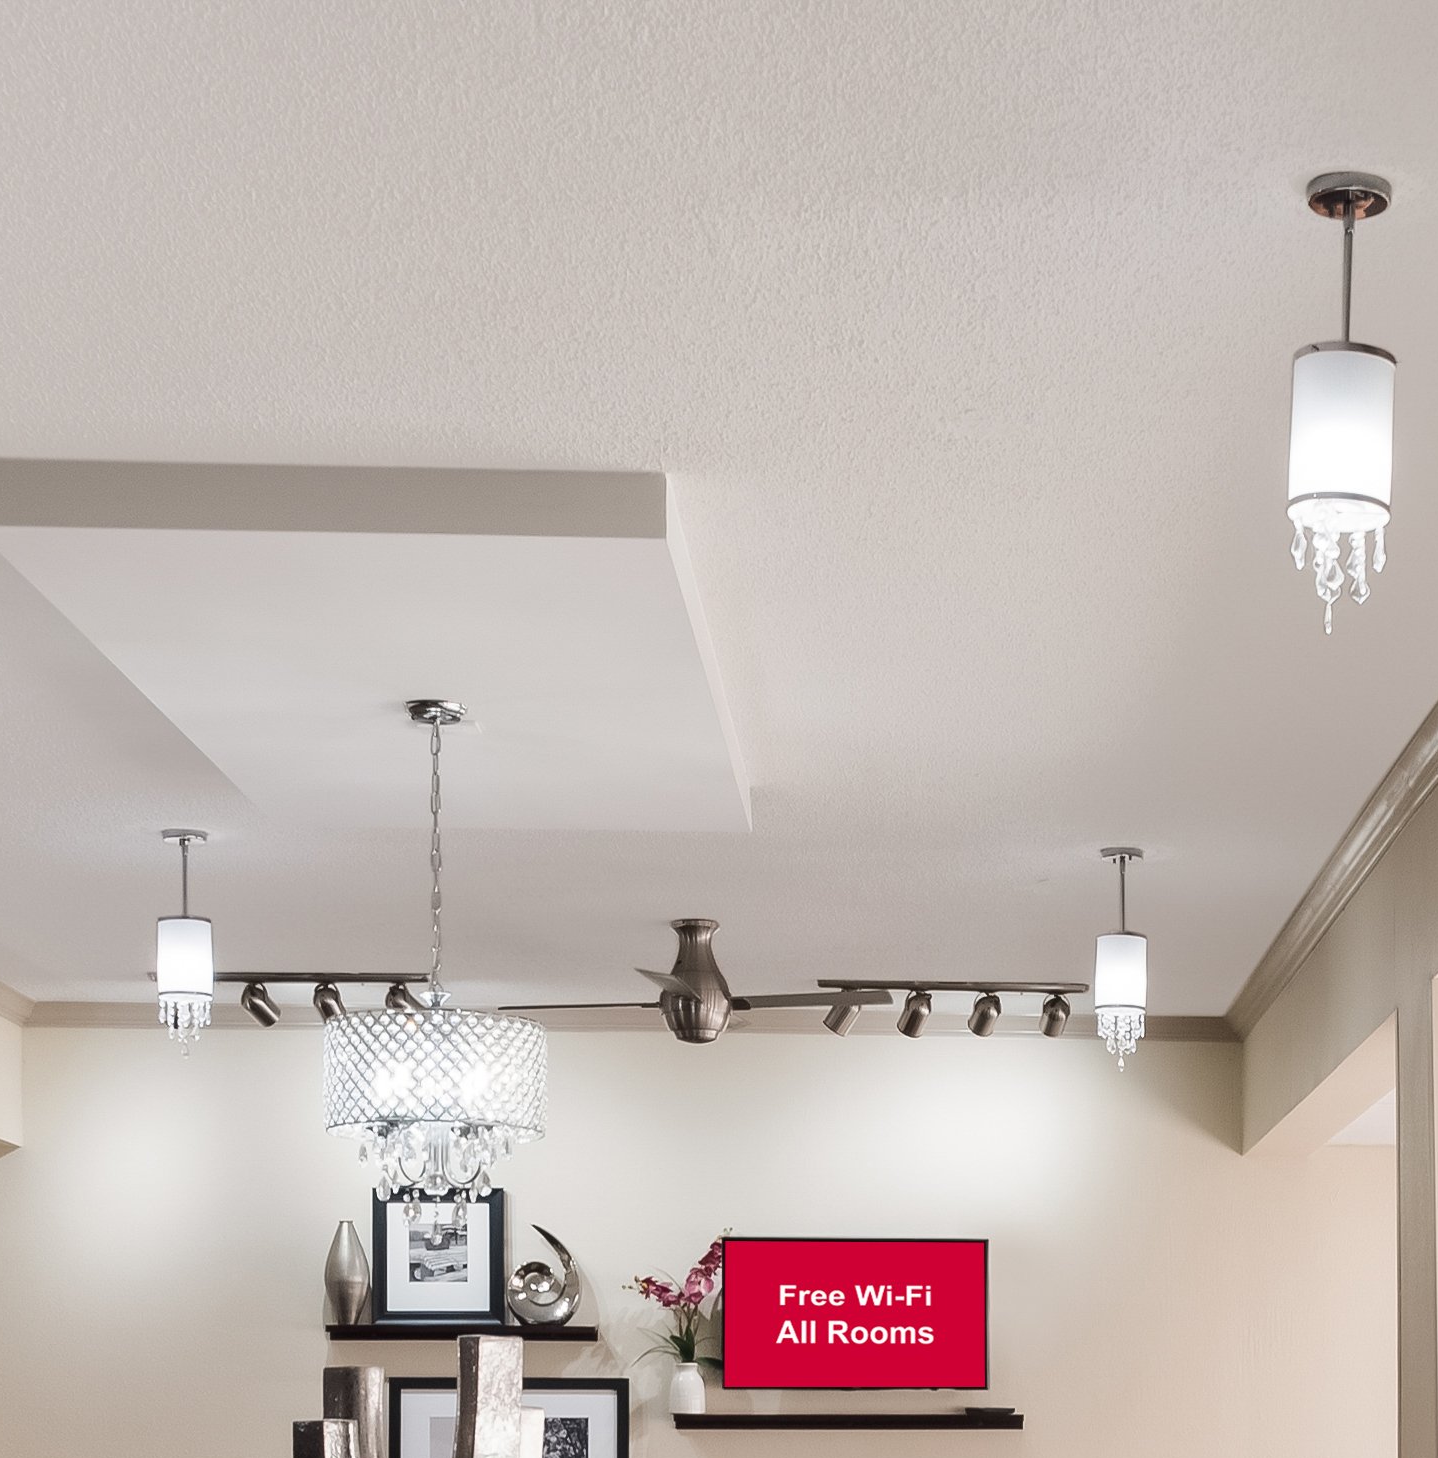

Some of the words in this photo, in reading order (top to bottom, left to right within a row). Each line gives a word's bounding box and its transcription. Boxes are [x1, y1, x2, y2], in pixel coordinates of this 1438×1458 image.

[779, 1285, 845, 1306] Free
[855, 1285, 931, 1306] Wi-Fi
[776, 1320, 816, 1344] All
[828, 1320, 934, 1345] Rooms
